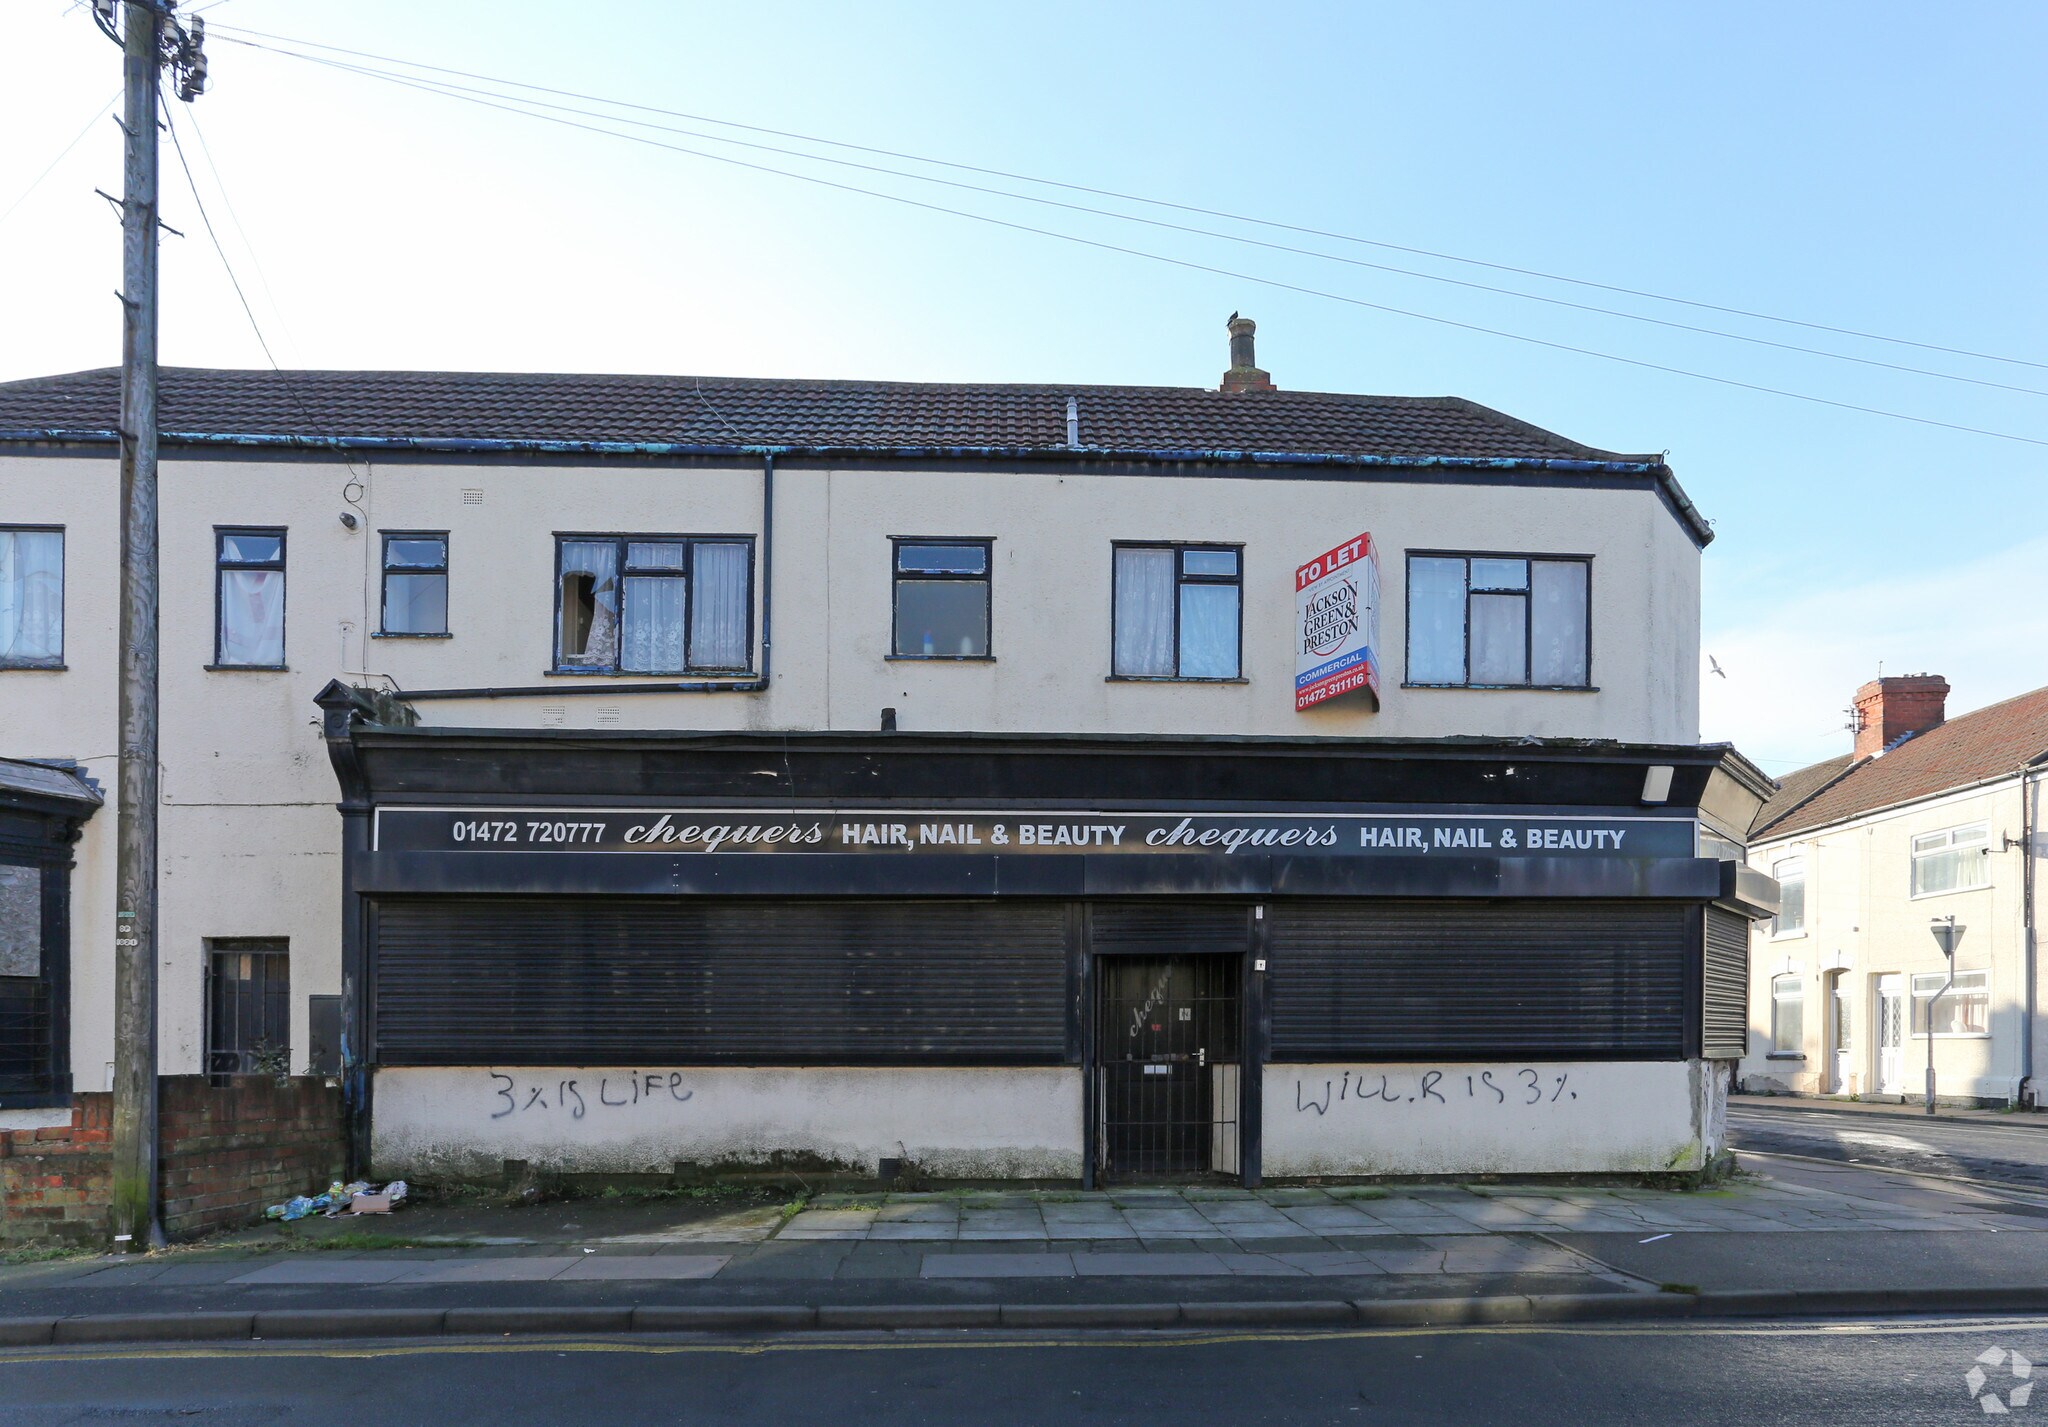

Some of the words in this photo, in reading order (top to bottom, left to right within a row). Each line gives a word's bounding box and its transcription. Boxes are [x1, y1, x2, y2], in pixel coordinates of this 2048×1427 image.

[1299, 562, 1321, 586] TO
[1327, 539, 1362, 573] LET
[1304, 580, 1358, 622] JACKSON
[1303, 615, 1359, 655] PRESTON
[1299, 653, 1362, 684] COMMERCIAL
[1298, 687, 1327, 707] 01472
[1328, 673, 1364, 695] 311116
[453, 821, 517, 842] 01472
[527, 821, 606, 843] 720777
[623, 814, 823, 853] chequers
[842, 824, 914, 851] HAIR,
[920, 824, 981, 845] NAIL
[990, 824, 1009, 845] &
[1019, 825, 1126, 846] BEAUTY
[1145, 817, 1338, 854] chequers
[1360, 827, 1429, 853] HAIR,
[1434, 827, 1492, 849] NAIL
[1500, 828, 1518, 849] &
[1526, 829, 1626, 850] BEAUTY
